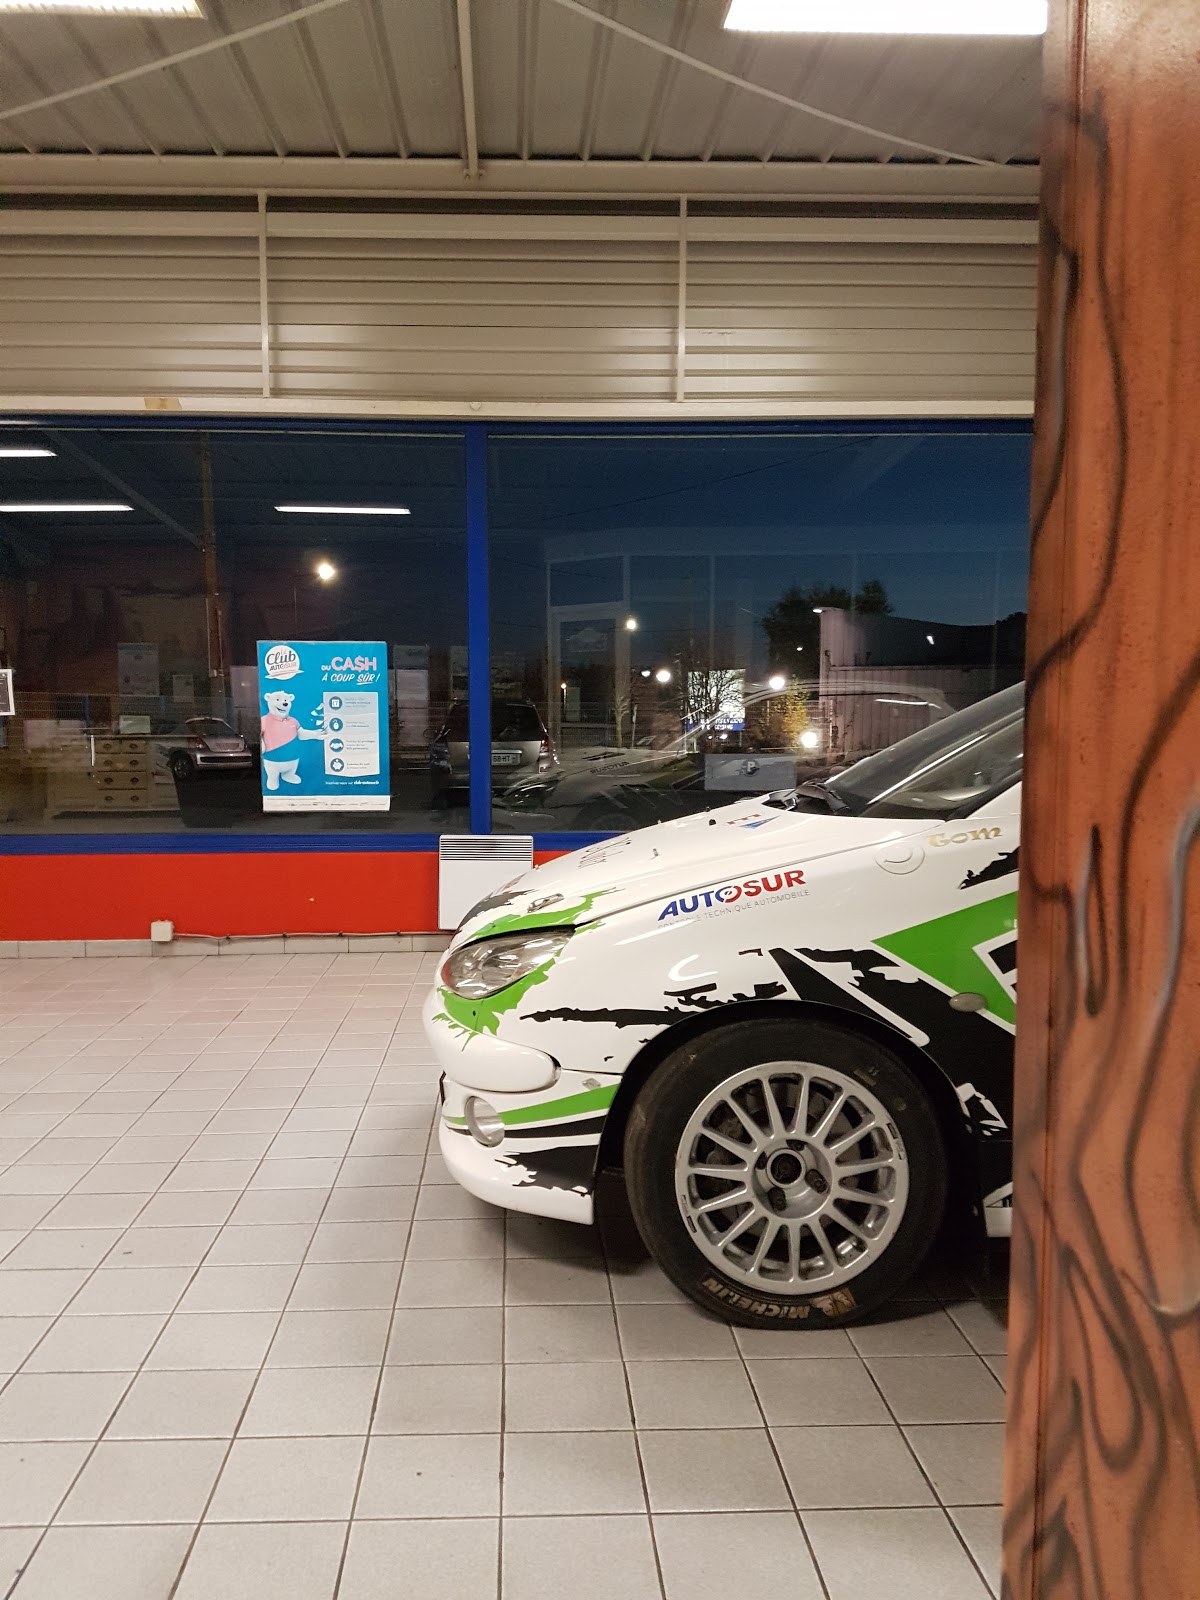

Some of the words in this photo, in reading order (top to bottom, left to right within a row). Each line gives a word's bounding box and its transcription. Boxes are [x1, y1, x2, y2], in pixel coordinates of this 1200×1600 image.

[267, 650, 296, 666] Club
[269, 662, 297, 671] AUTOSUR
[330, 673, 355, 682] COUP
[657, 869, 806, 921] AUTOSUR
[703, 902, 753, 919] TECHNIQUE
[755, 889, 811, 909] AUTOMOBILE
[702, 1278, 811, 1319] MICHELIN
